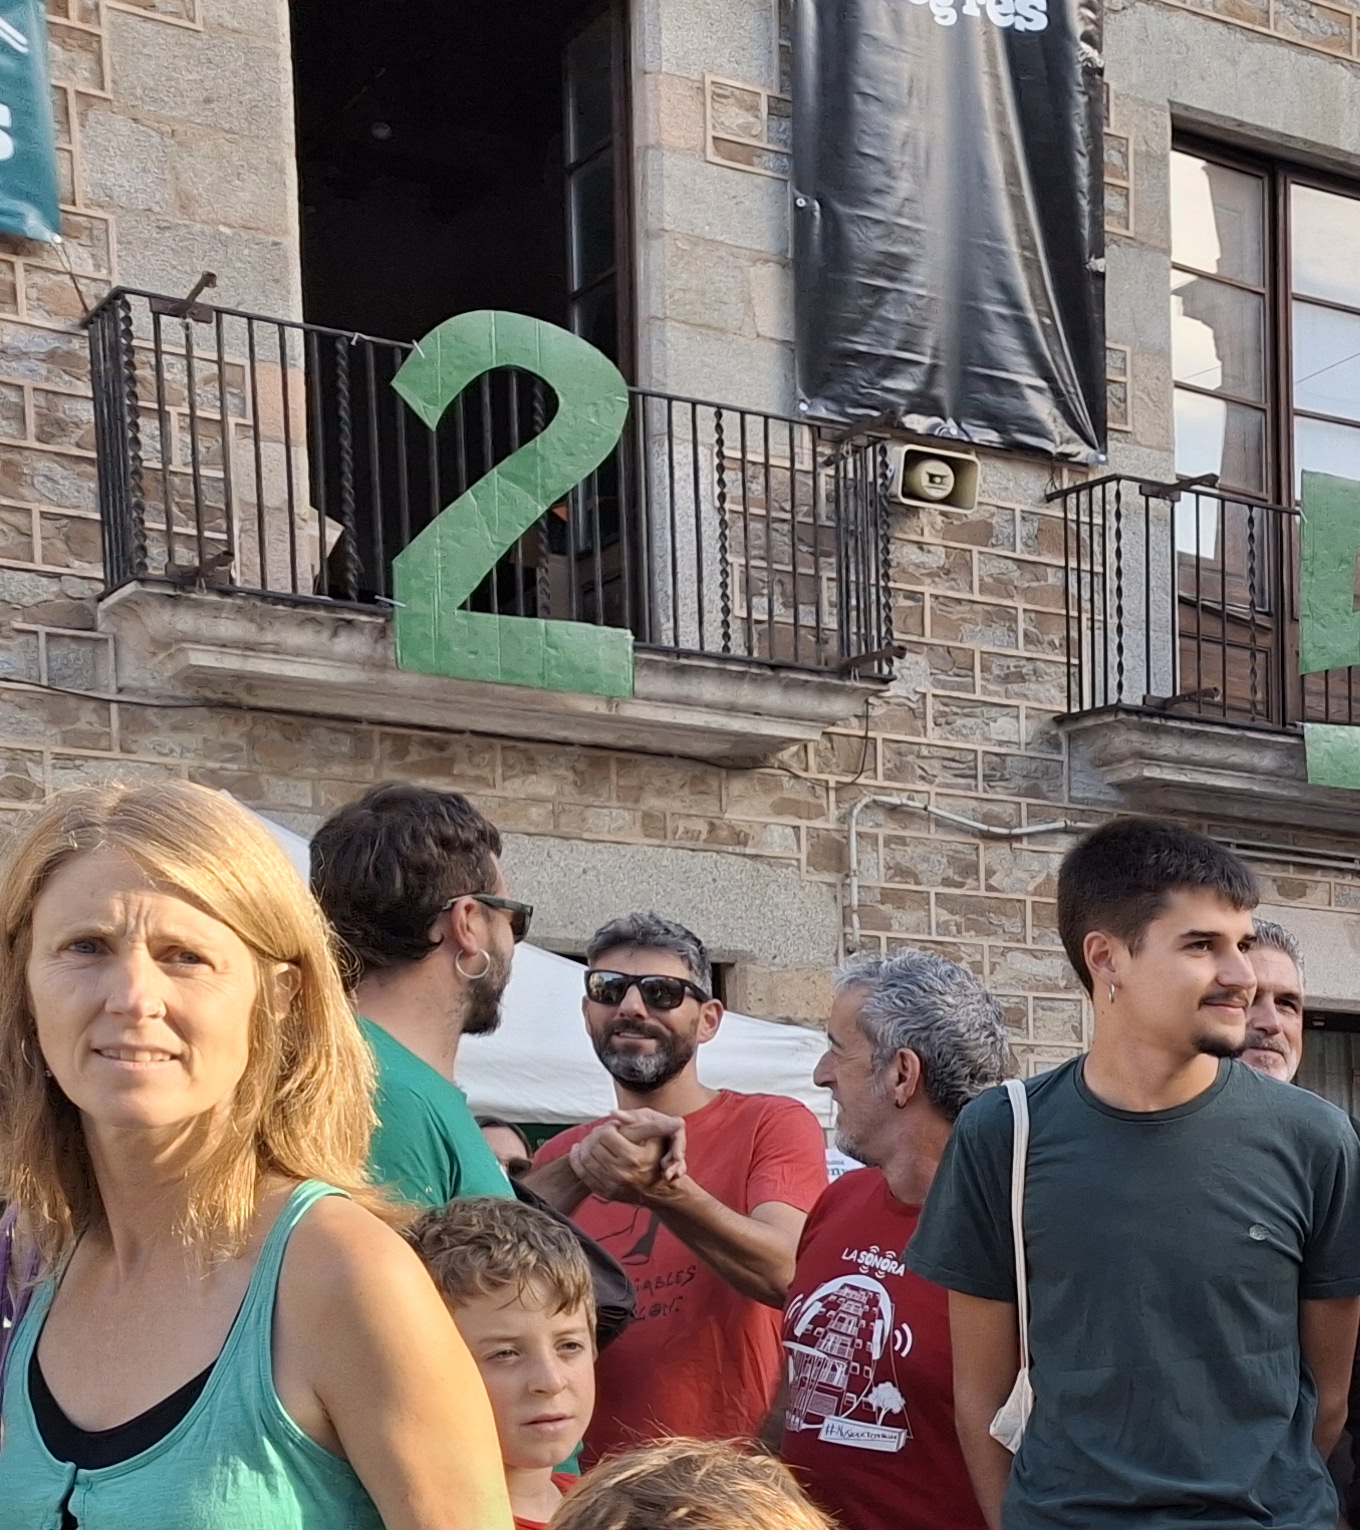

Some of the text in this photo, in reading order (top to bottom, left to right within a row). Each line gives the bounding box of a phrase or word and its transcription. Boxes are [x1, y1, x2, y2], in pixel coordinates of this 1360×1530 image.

[905, 0, 1049, 32] gres
[390, 310, 635, 698] 2
[841, 1247, 906, 1277] LA SONORA
[634, 1264, 697, 1298] iABLES
